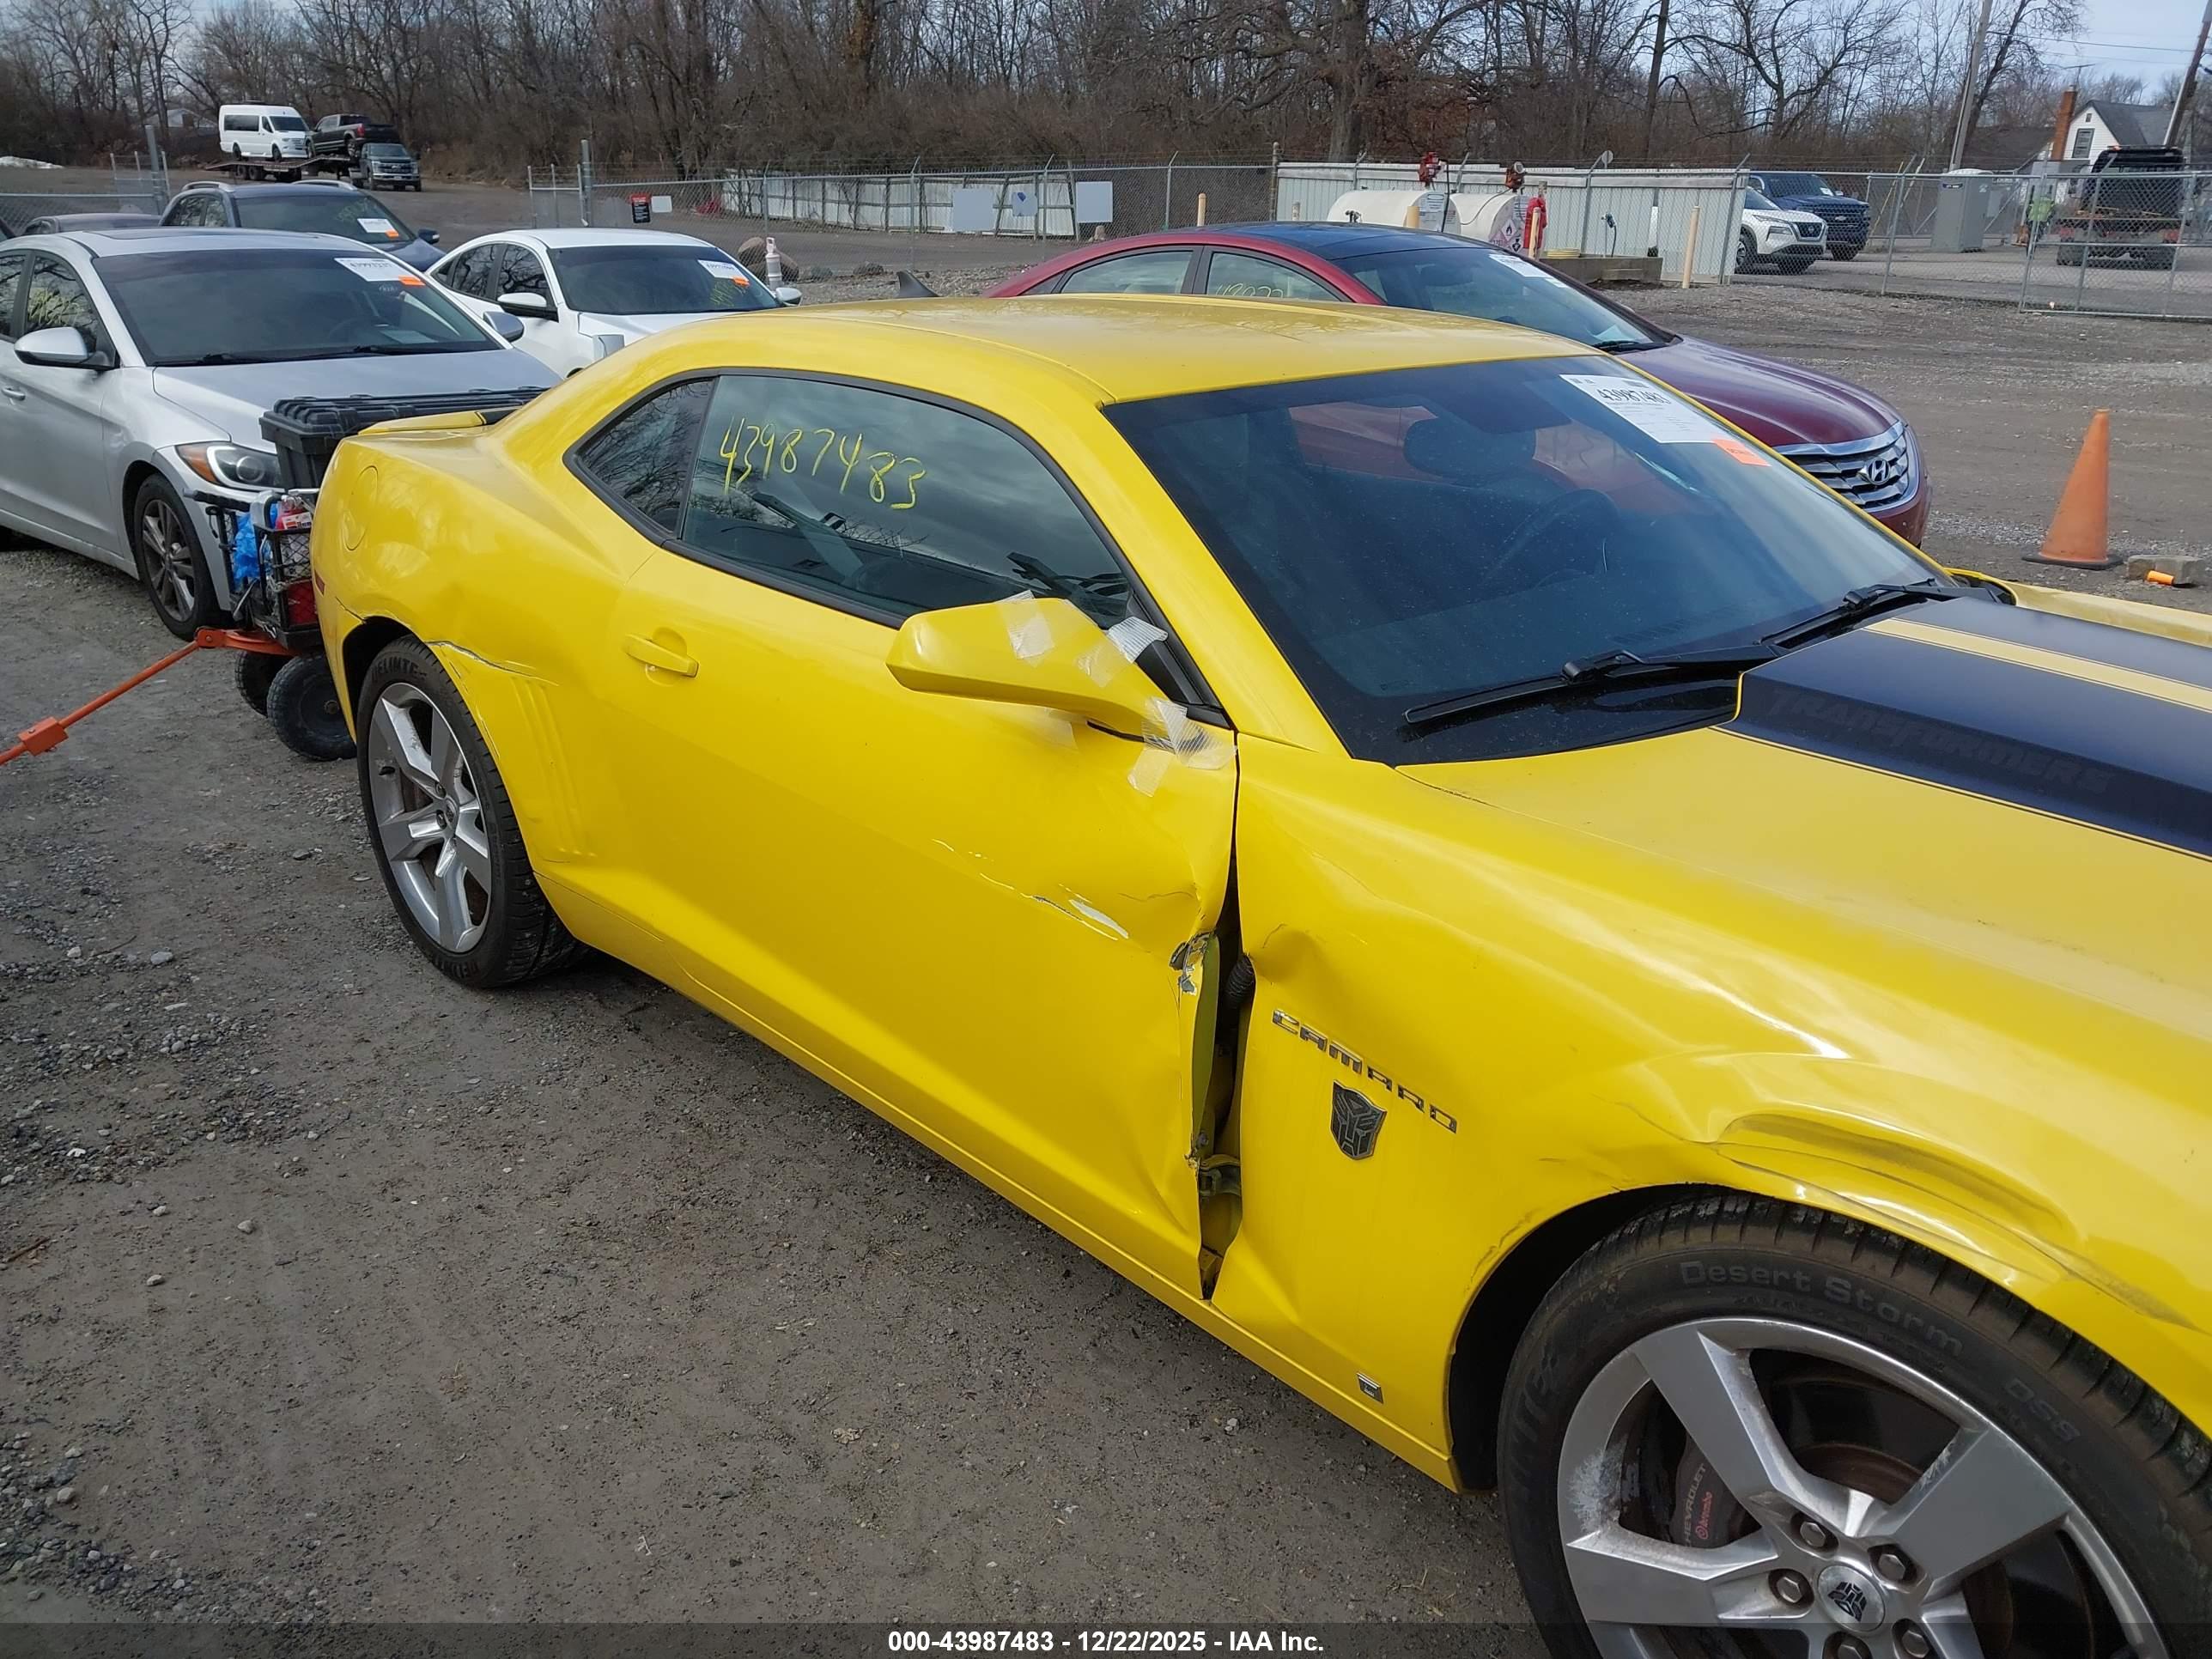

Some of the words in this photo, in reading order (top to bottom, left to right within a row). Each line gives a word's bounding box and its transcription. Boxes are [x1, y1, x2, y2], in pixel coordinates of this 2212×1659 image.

[719, 416, 927, 510] 43987483
[1766, 687, 2116, 793] TRANSFORMERS
[1271, 1008, 1458, 1134] CAMARO
[1680, 1260, 1812, 1292] Desert
[1822, 1275, 1964, 1358] Storm
[1684, 1463, 1706, 1547] HEVROLET
